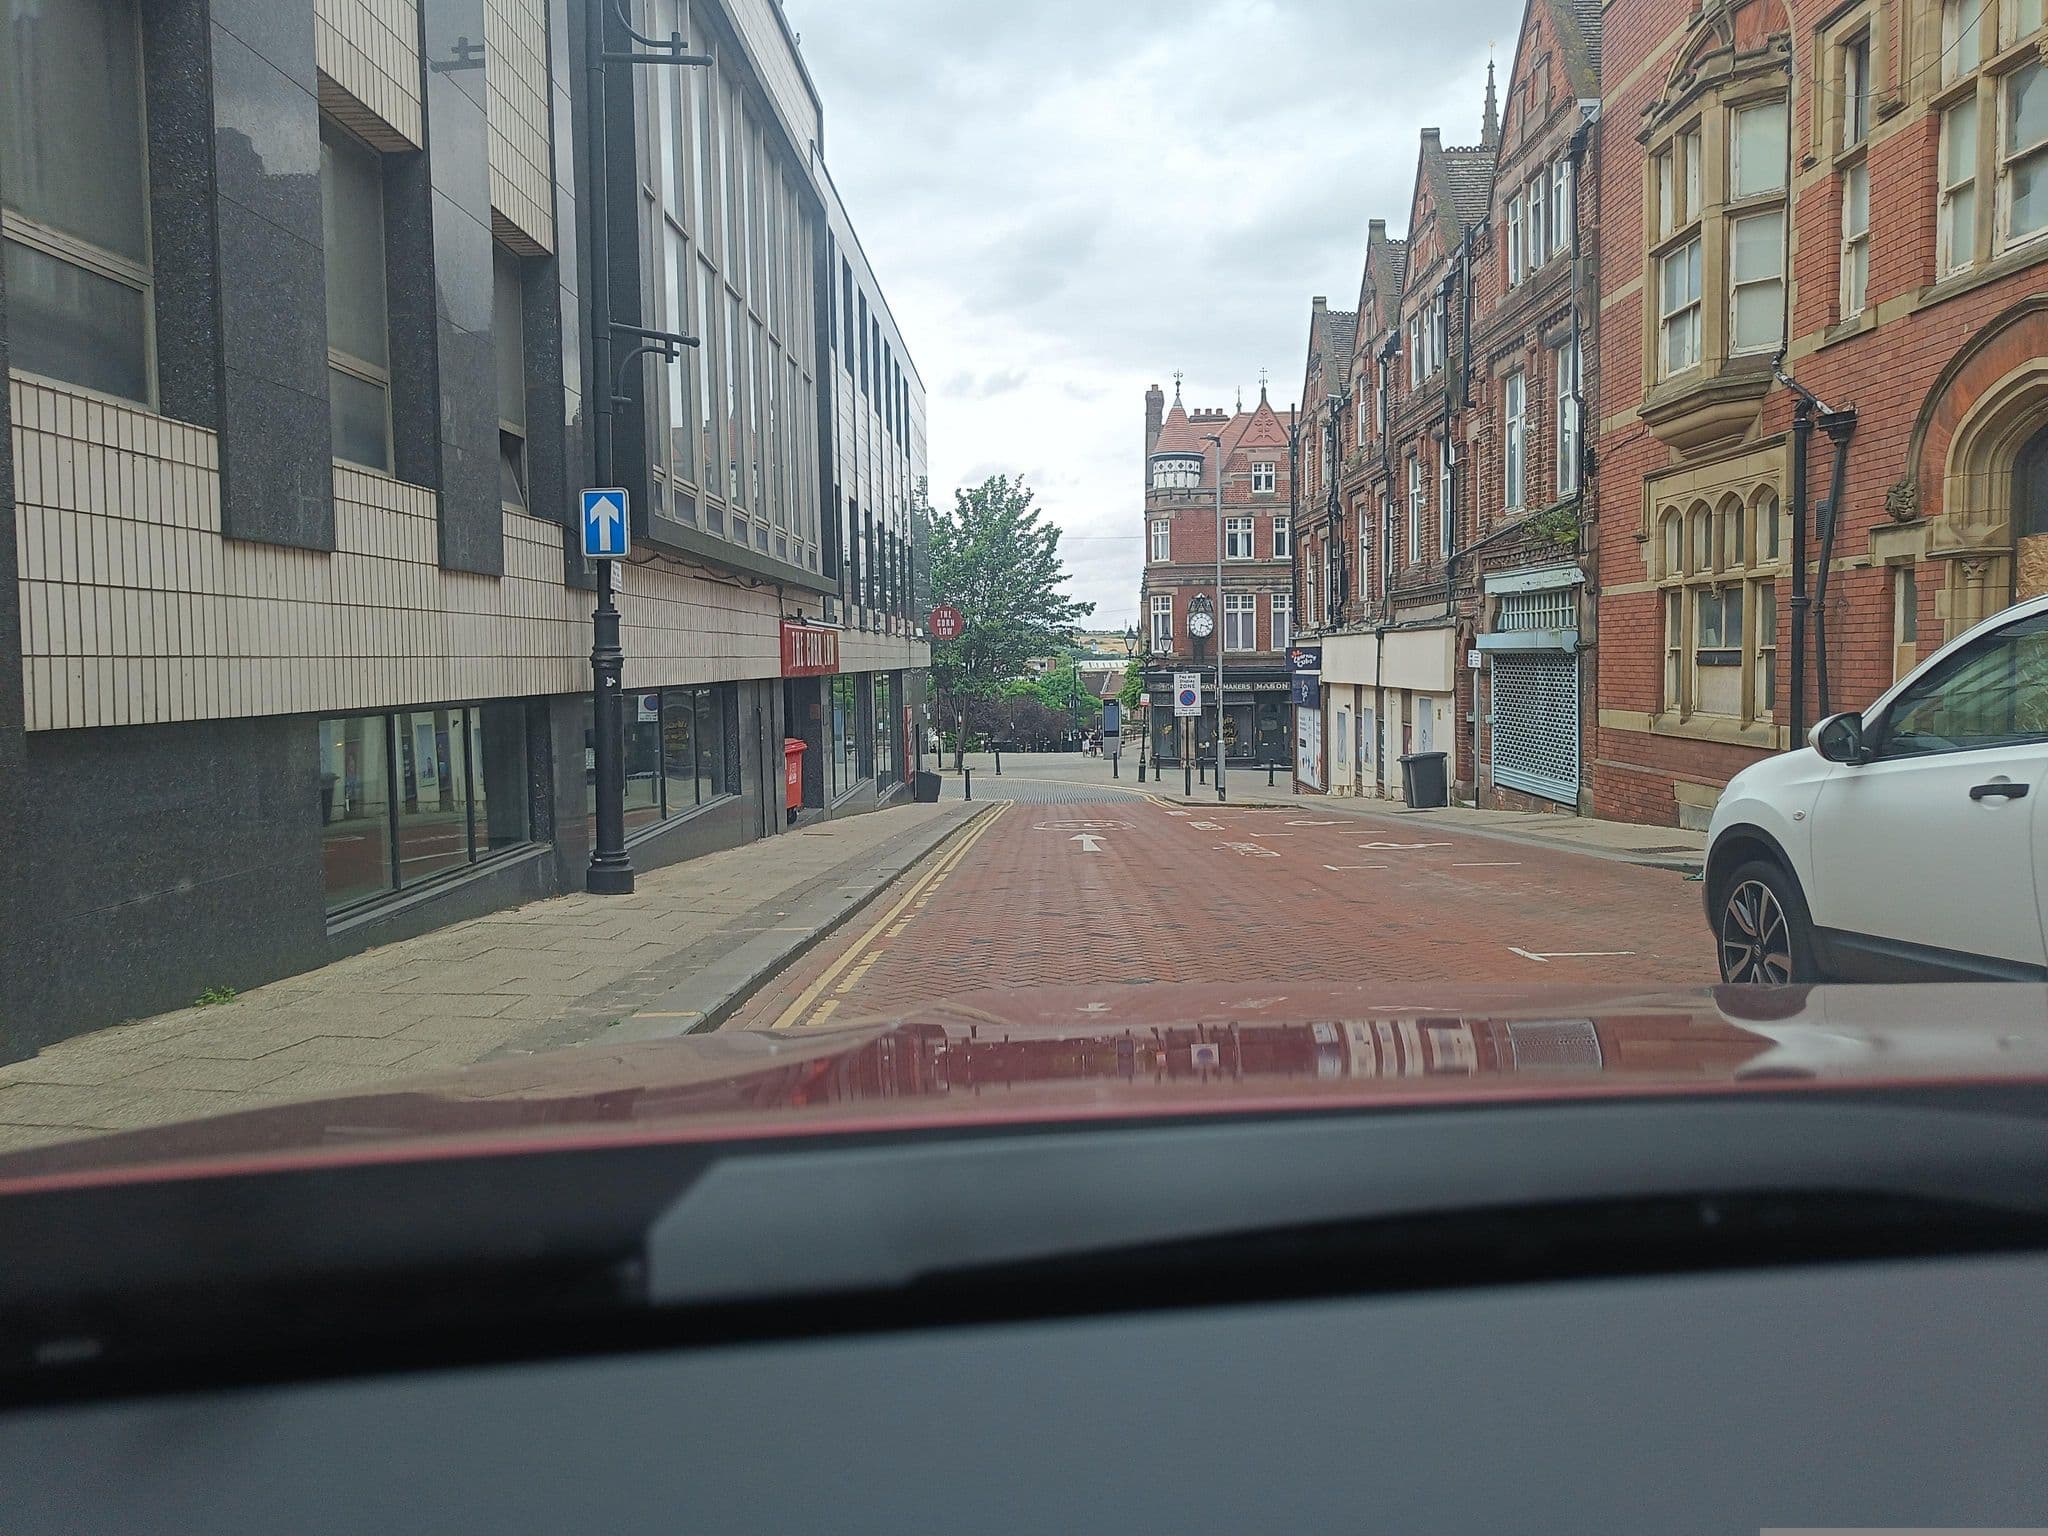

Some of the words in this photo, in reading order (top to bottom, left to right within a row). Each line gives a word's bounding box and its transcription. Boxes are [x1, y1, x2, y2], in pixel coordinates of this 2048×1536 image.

[940, 610, 952, 618] THE
[936, 618, 955, 627] CORN
[938, 627, 953, 635] LAW
[792, 631, 804, 667] THE
